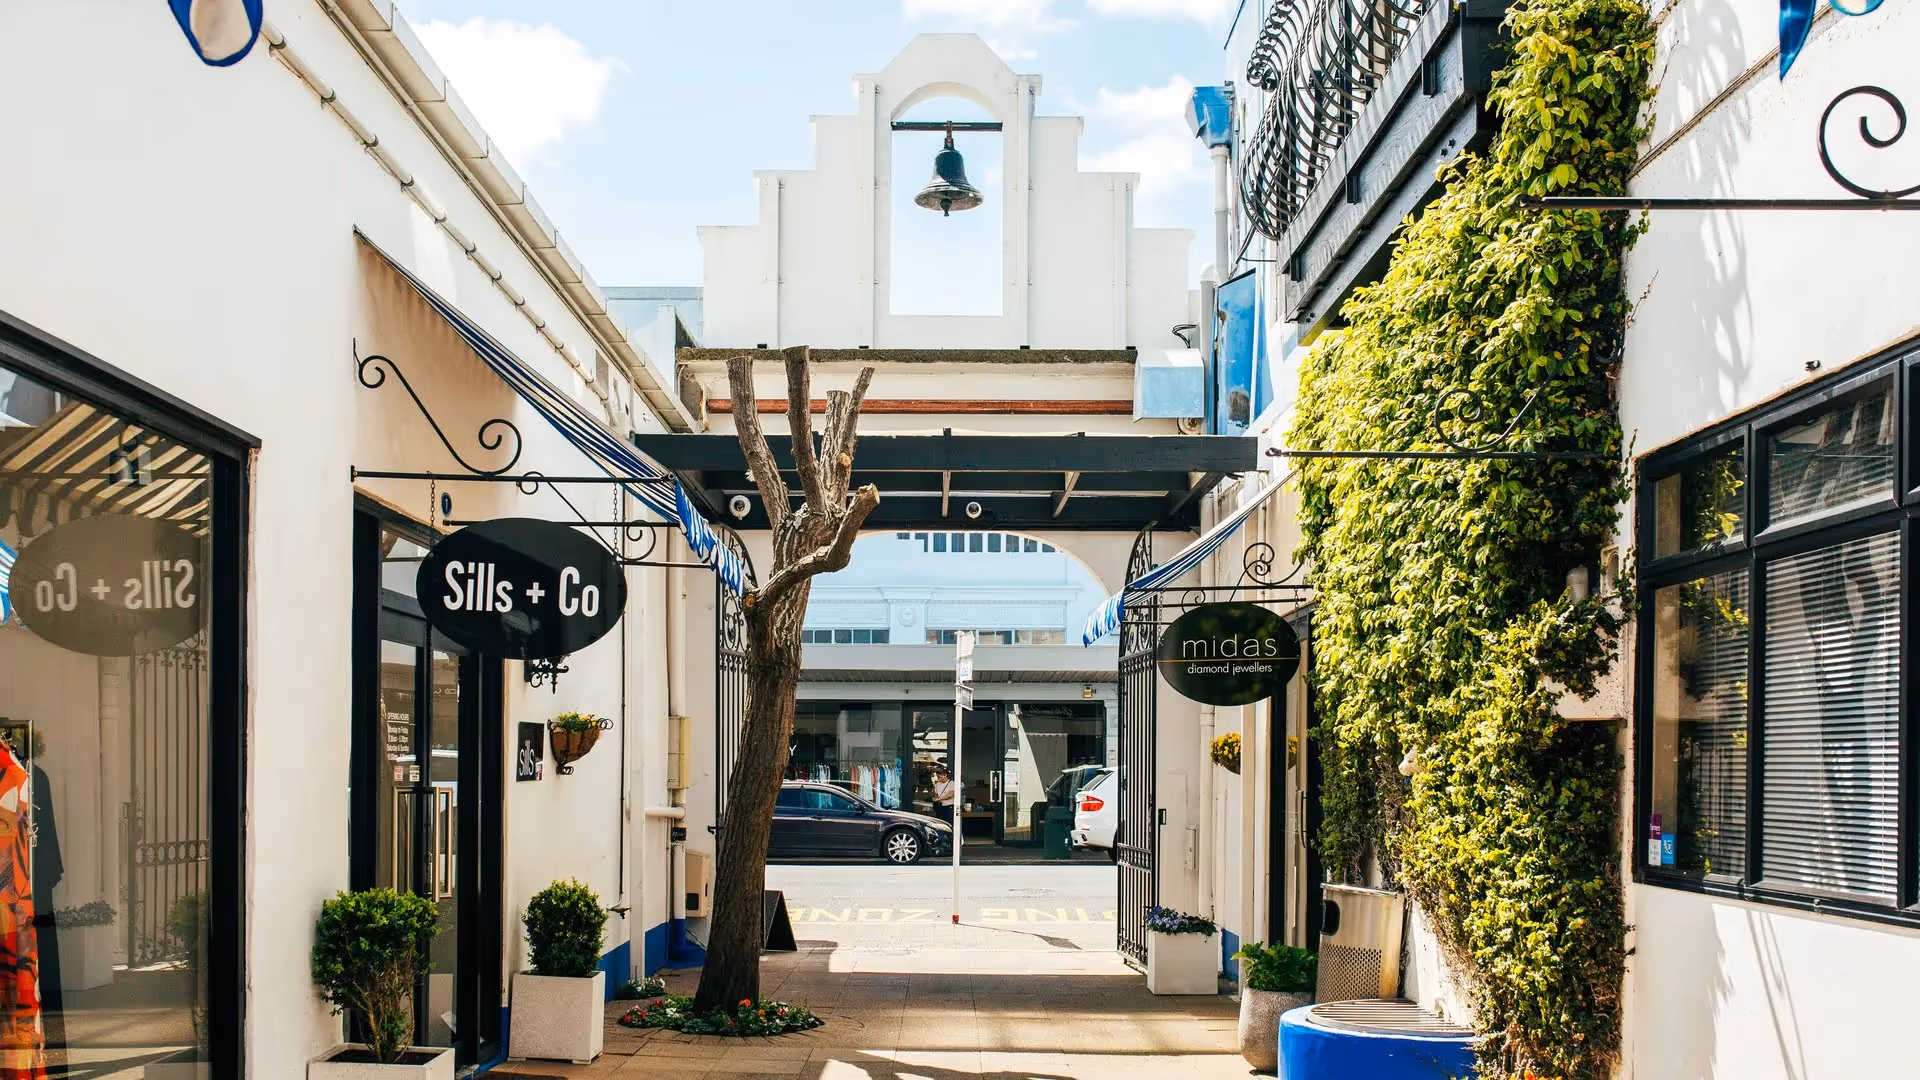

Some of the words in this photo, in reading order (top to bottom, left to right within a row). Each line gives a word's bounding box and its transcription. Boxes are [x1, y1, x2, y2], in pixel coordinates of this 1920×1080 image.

[443, 560, 514, 613] Sills
[526, 582, 545, 604] +
[558, 566, 599, 617] Co
[1182, 633, 1277, 658] midas
[1187, 662, 1229, 674] diamond
[1232, 661, 1273, 675] jewellers
